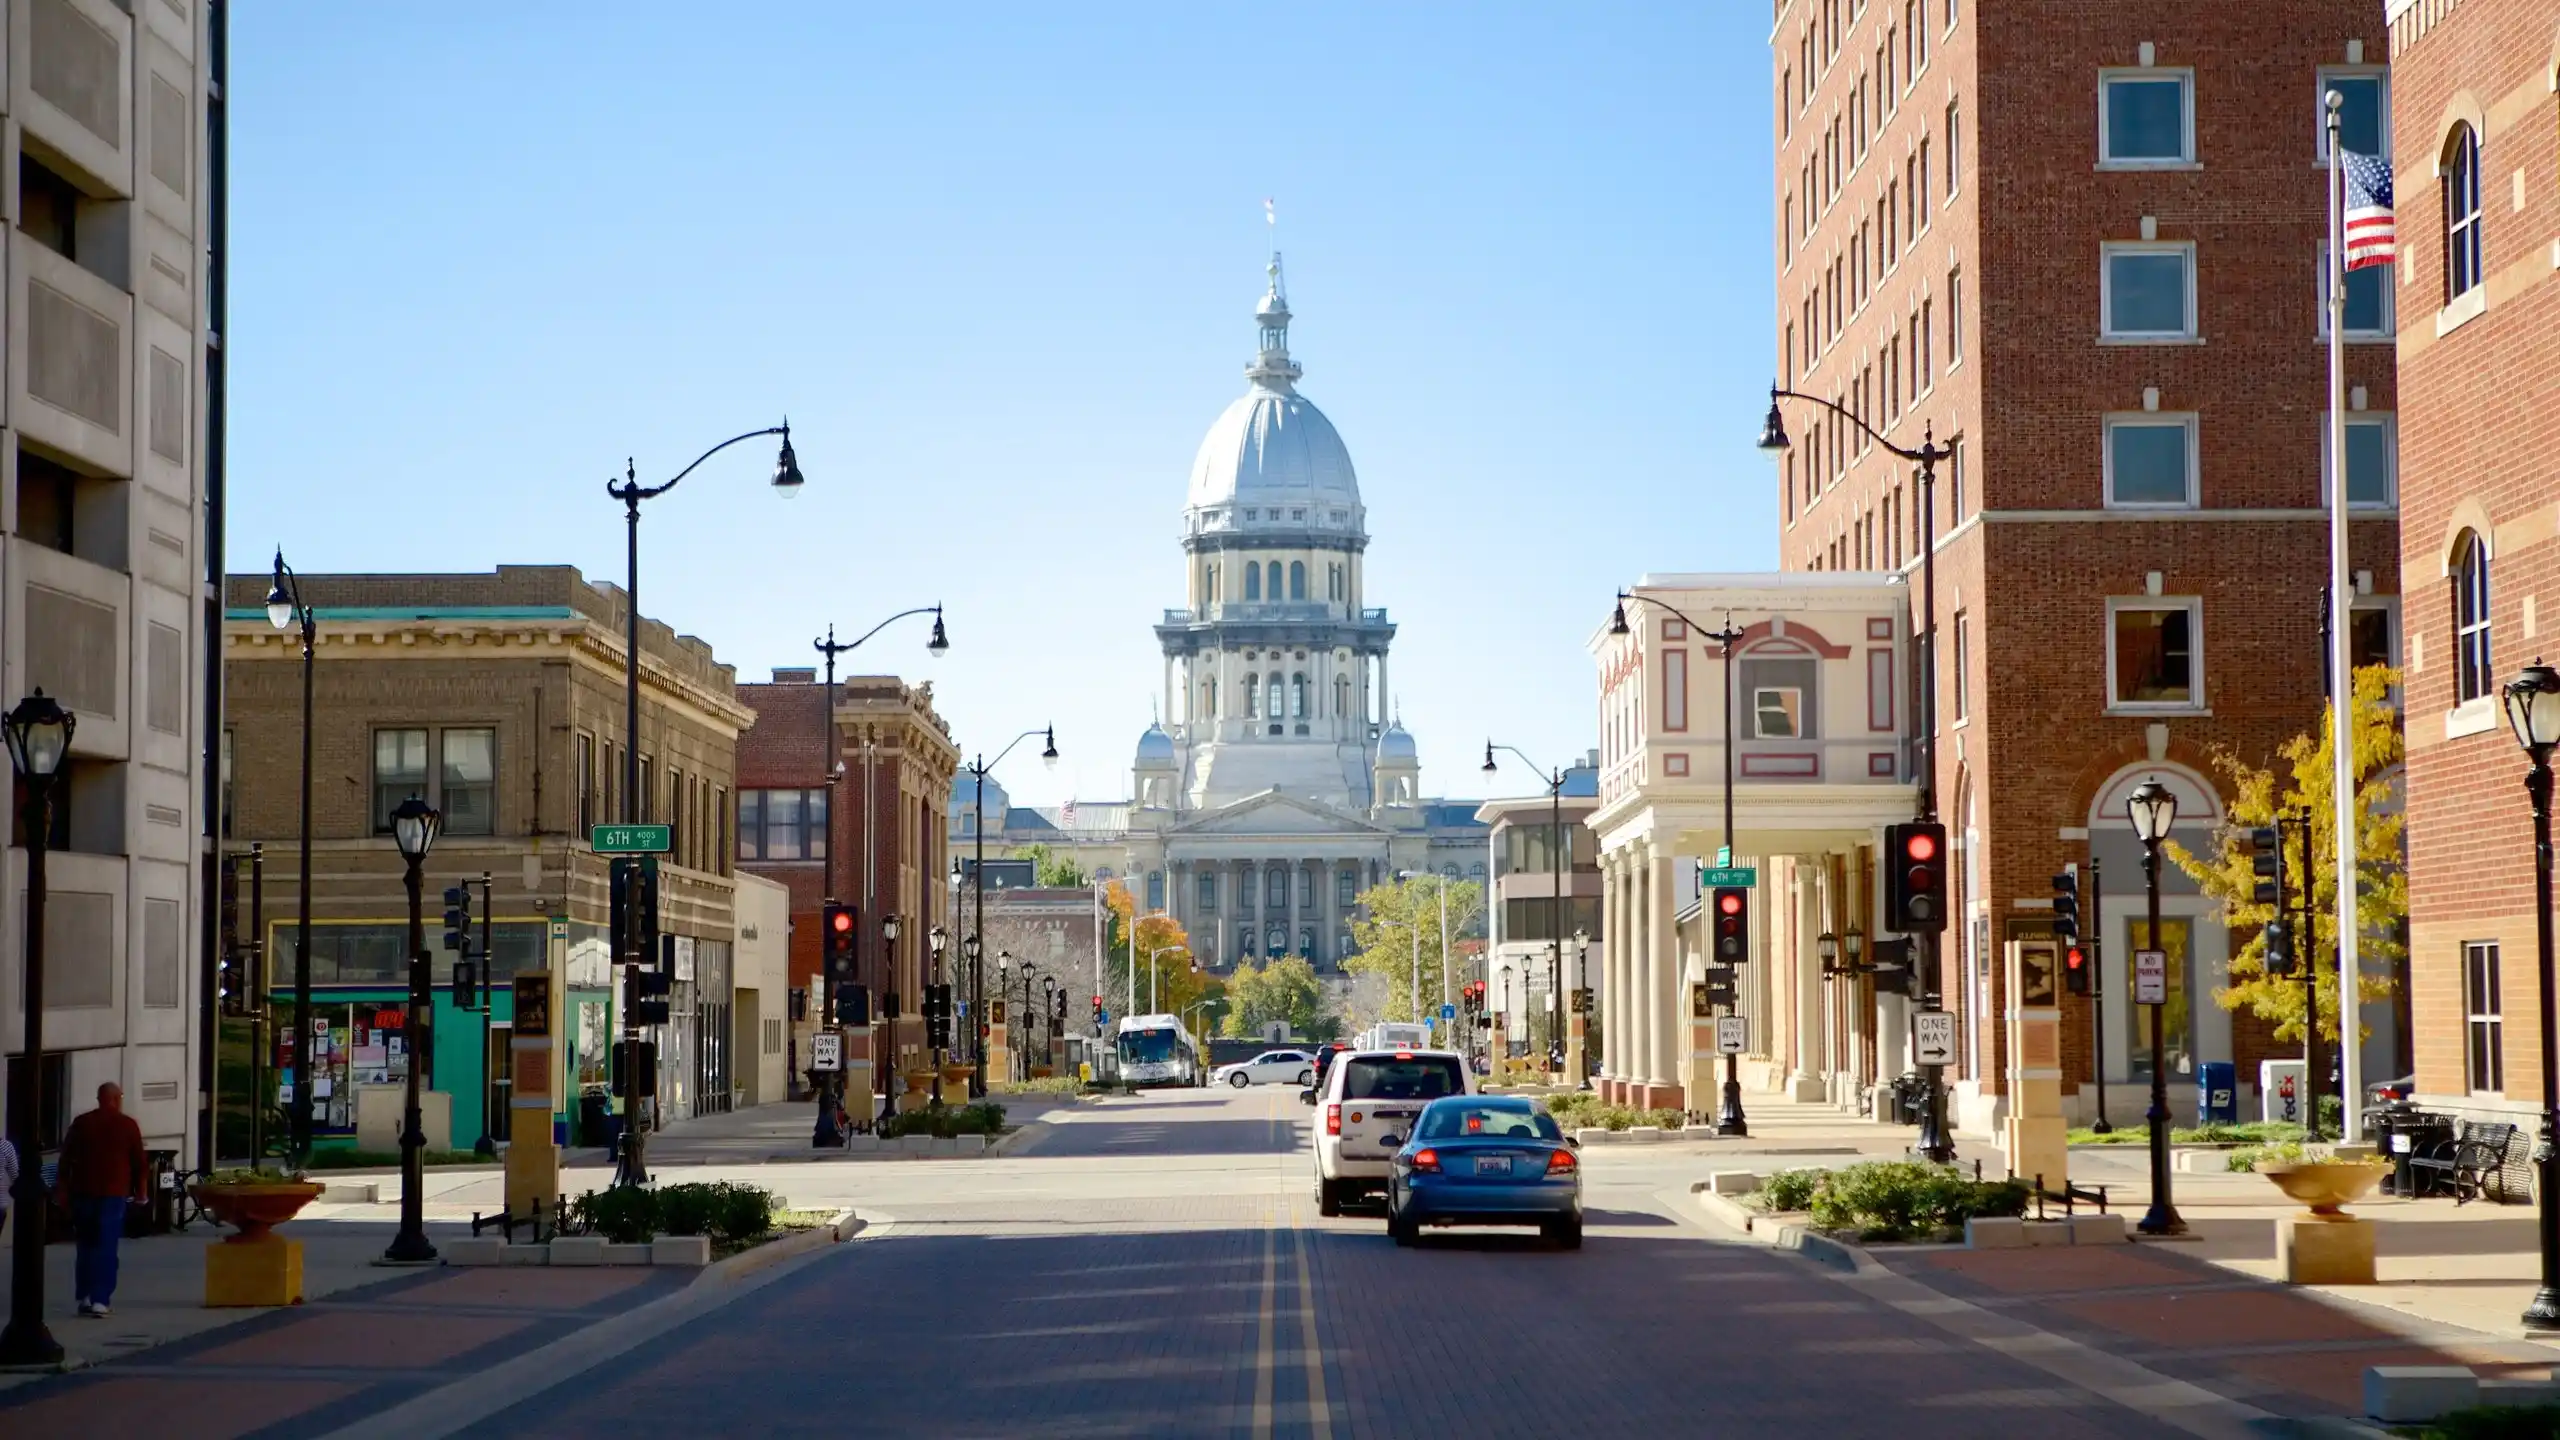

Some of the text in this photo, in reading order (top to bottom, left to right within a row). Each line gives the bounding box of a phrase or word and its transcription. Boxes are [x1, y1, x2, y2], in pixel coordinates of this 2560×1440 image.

[606, 831, 630, 845] 6TH
[641, 840, 650, 848] ST
[1711, 872, 1729, 883] 6TH
[1722, 1021, 1741, 1030] ONE
[1921, 1018, 1949, 1030] ONE
[1721, 1031, 1742, 1039] WAY
[1921, 1032, 1949, 1044] WAY
[817, 1038, 837, 1047] ONE
[817, 1047, 837, 1056] WAY
